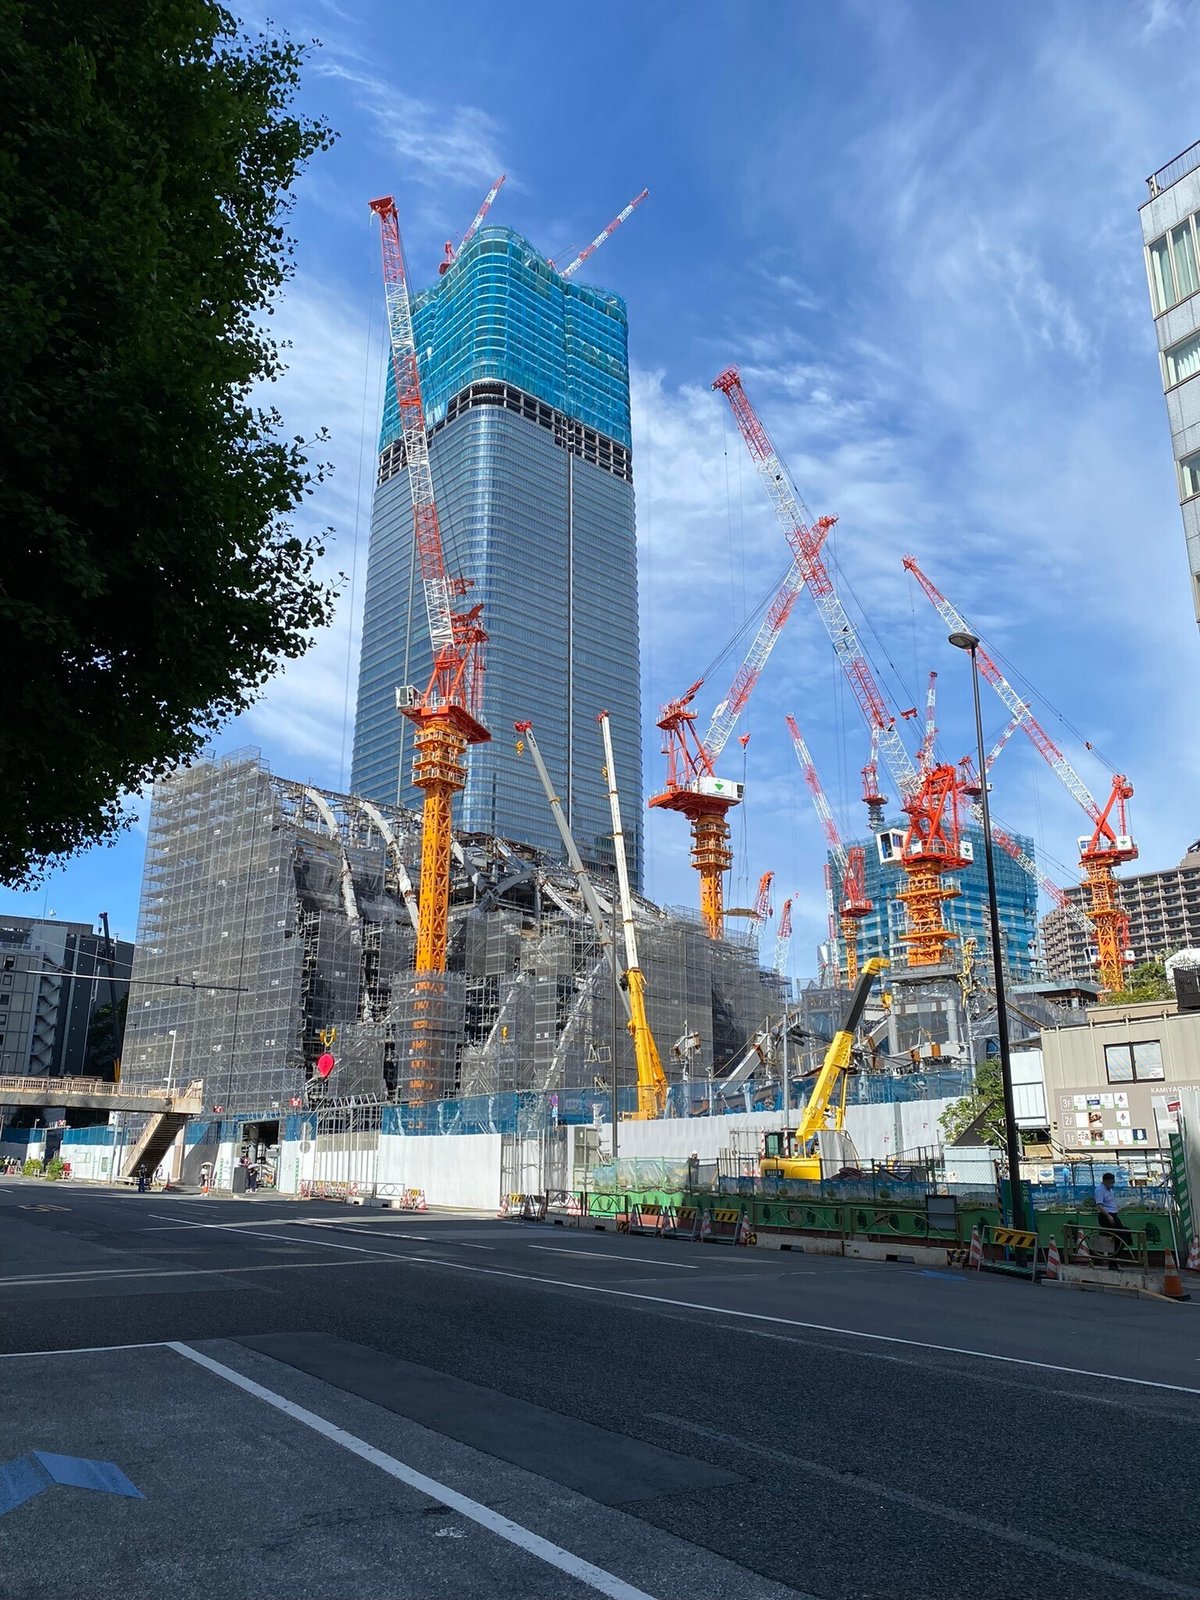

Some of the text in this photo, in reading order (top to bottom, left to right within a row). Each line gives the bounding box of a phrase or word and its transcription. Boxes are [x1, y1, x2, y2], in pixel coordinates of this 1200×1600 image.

[1151, 1085, 1191, 1093] KAMIYACHO
[1062, 1099, 1071, 1108] 3F
[1064, 1117, 1073, 1126] 2F
[1066, 1134, 1075, 1143] 1F
